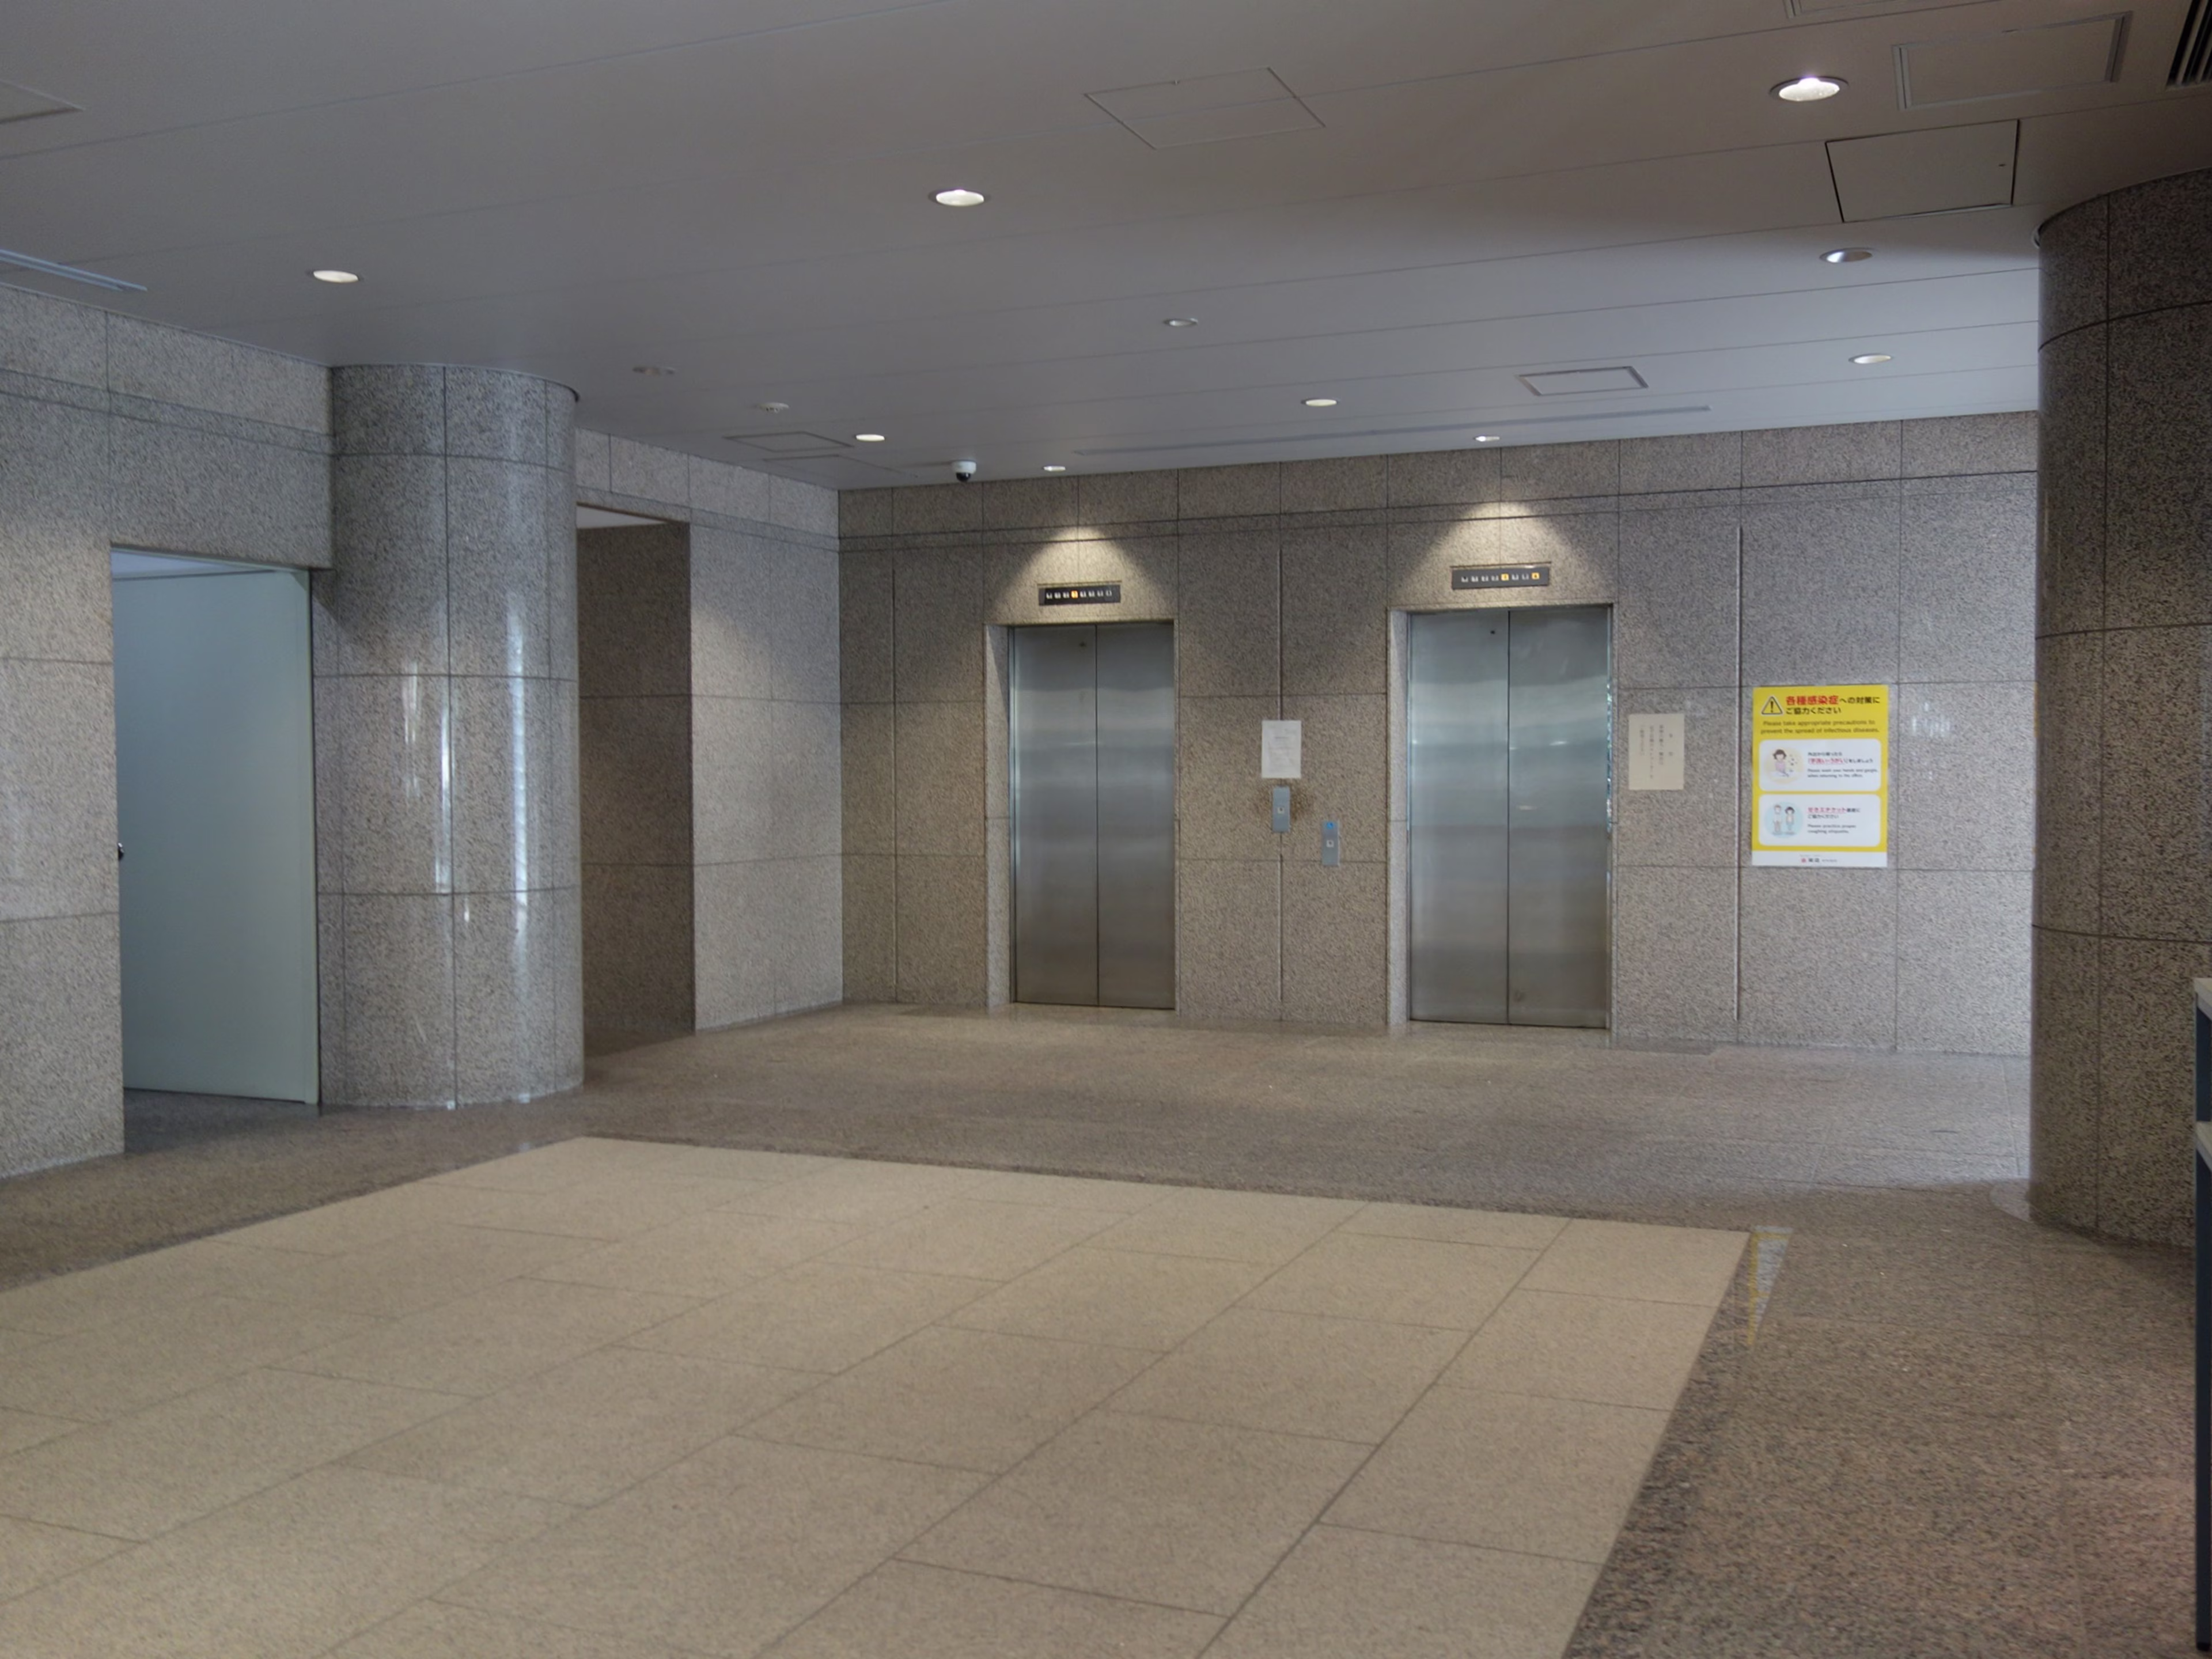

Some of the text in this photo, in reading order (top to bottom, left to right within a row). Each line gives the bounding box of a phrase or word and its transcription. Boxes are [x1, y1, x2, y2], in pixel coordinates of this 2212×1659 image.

[1786, 695, 1880, 706] 各種感染症への対策に
[1786, 707, 1842, 715] ご協力ください
